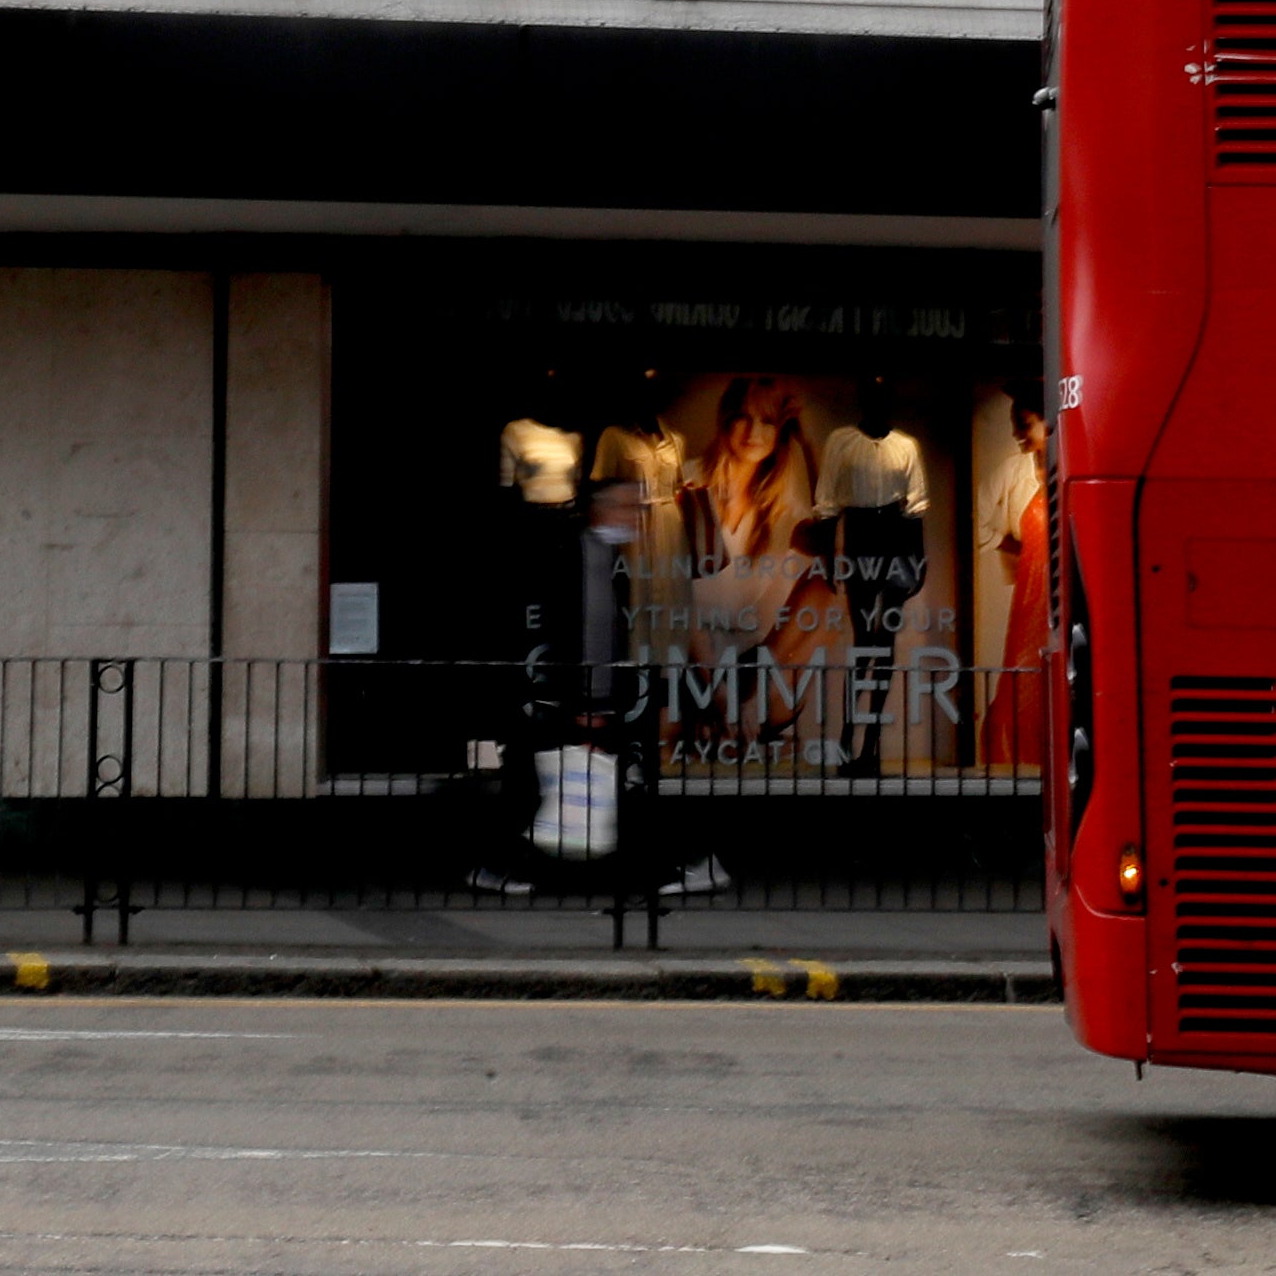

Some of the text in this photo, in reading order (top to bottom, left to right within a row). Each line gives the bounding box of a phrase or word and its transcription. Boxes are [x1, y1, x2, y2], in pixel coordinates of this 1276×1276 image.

[611, 553, 927, 581] ALING BROADWAY
[525, 604, 957, 633] EYTHING FOR YOUR
